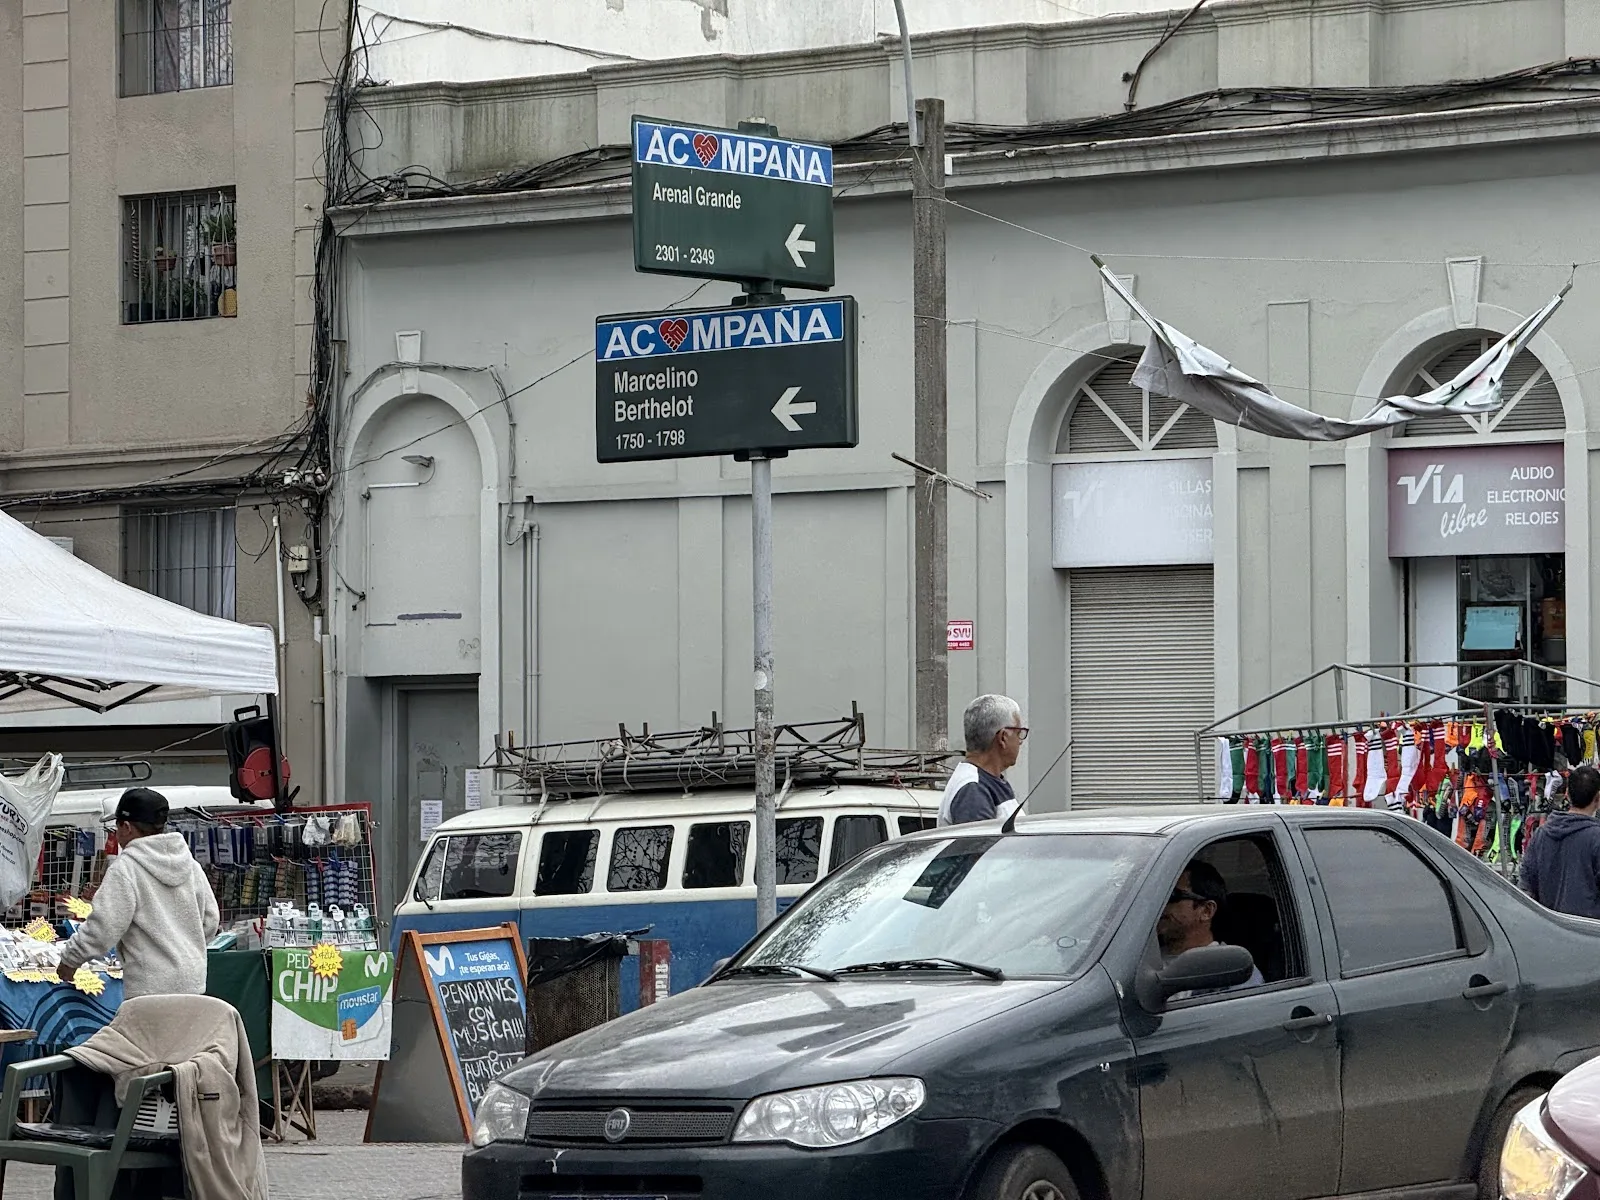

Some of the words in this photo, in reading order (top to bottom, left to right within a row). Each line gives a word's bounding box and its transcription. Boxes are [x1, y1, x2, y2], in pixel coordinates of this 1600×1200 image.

[653, 182, 692, 205] Arenal
[696, 186, 742, 210] Grande
[655, 244, 680, 263] 2301
[690, 247, 715, 265] 2349
[614, 366, 698, 394] Marcelino
[614, 395, 694, 423] Berthelot
[615, 432, 645, 450] 1750
[655, 429, 685, 447] 1798
[1510, 465, 1555, 481] AUDIO
[1169, 479, 1212, 495] SILLAS
[1440, 503, 1488, 538] libre
[1505, 511, 1559, 526] RELOJES
[952, 627, 971, 639] SVU
[464, 952, 478, 962] Tus
[478, 951, 500, 963] Gigas,
[470, 965, 496, 975] esperan
[497, 960, 511, 972] acá!
[278, 969, 339, 1003] CHIP
[439, 978, 519, 1009] PENDRIVES
[340, 991, 378, 1010] movistar
[468, 1005, 496, 1022] CON
